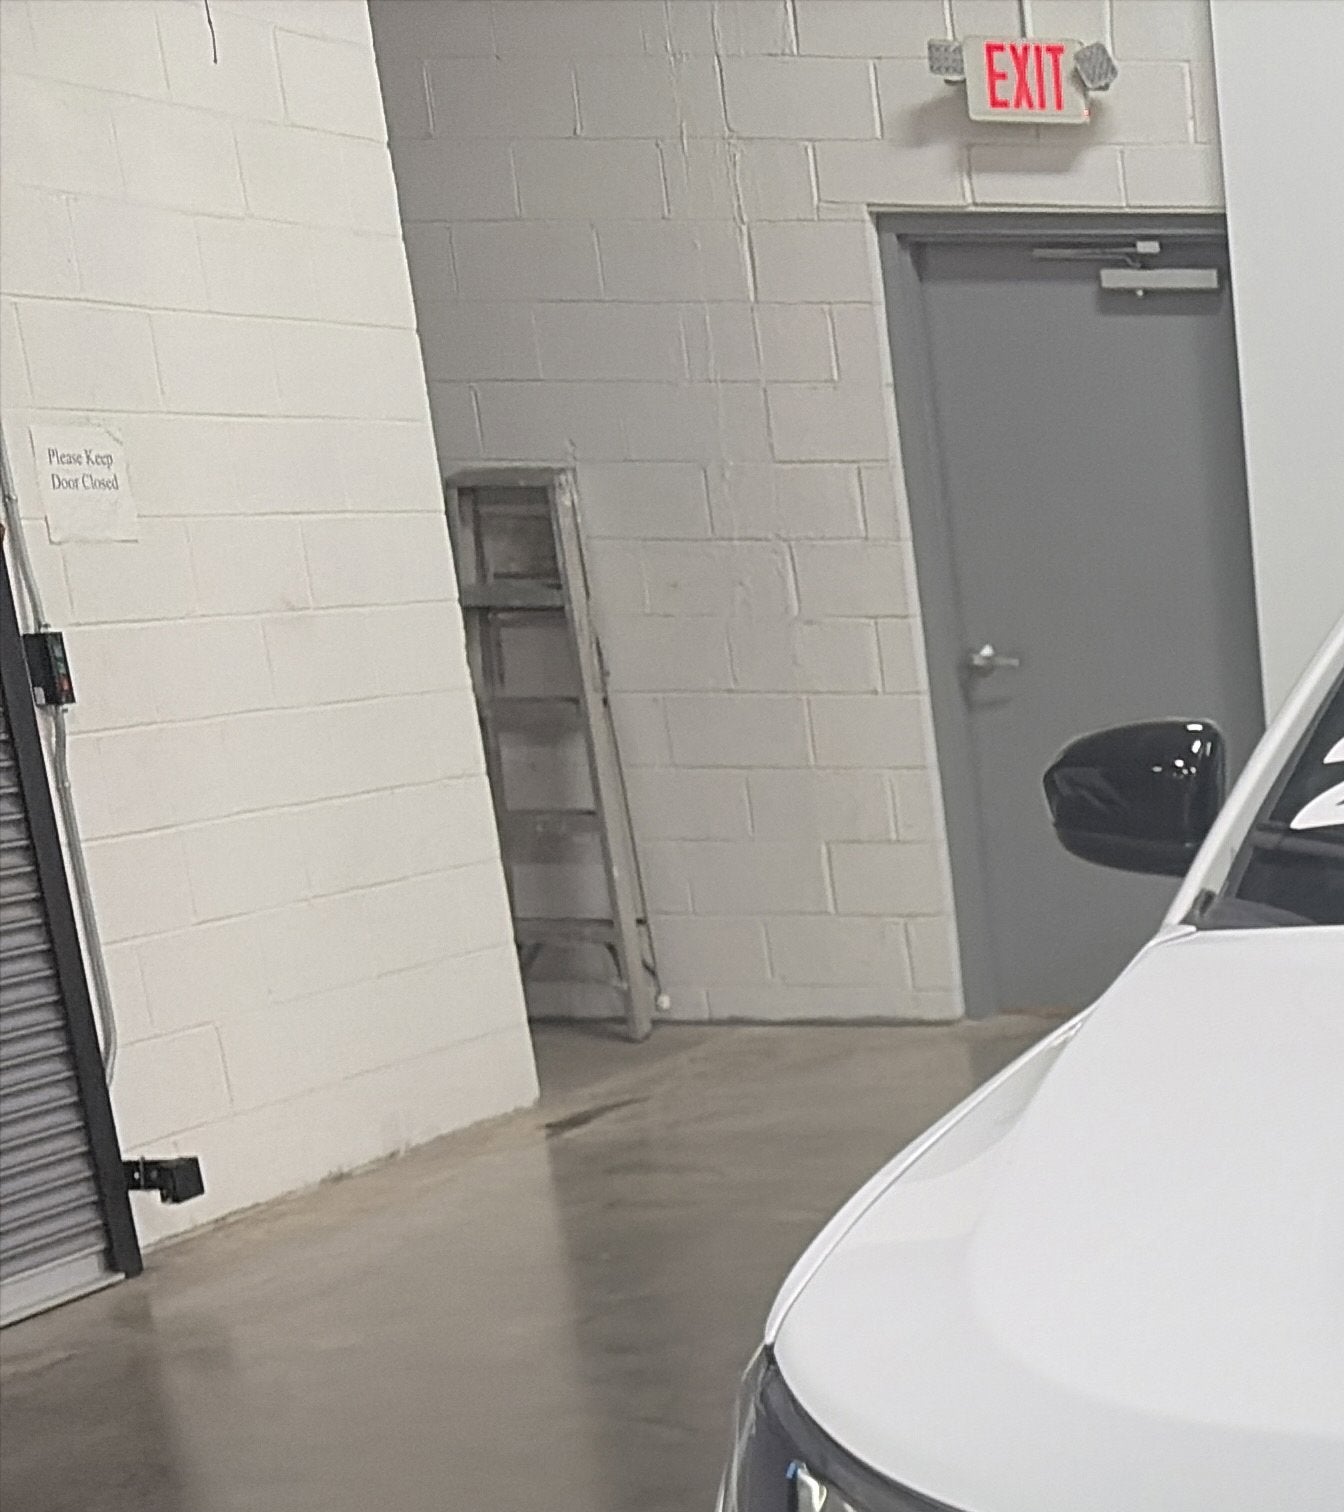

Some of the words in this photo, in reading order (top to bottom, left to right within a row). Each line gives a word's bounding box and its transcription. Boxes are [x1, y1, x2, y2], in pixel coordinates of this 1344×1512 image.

[985, 42, 1064, 111] EXIT
[48, 447, 82, 466] Please
[84, 448, 114, 469] Keep
[51, 473, 79, 490] Door
[82, 474, 119, 490] Closed
